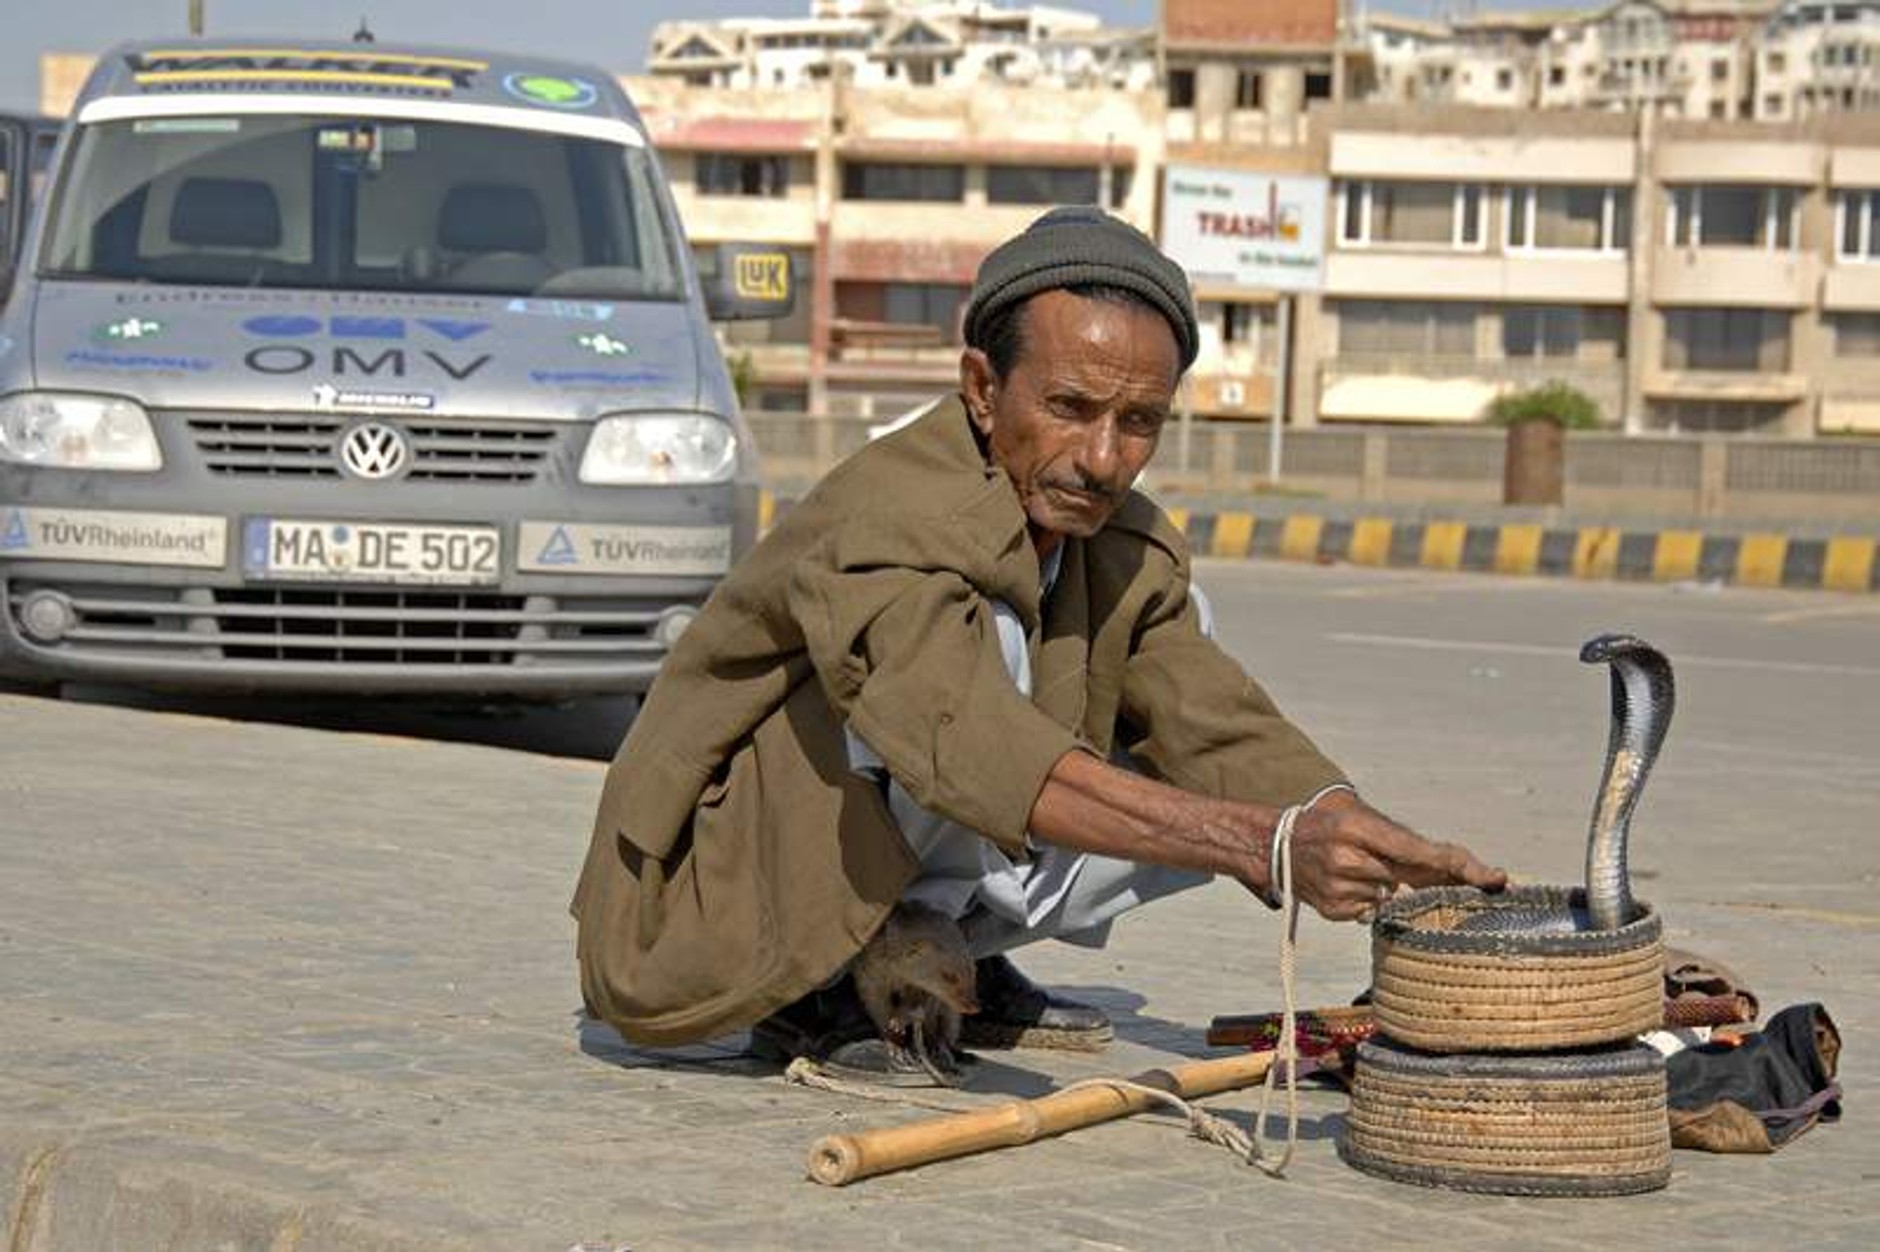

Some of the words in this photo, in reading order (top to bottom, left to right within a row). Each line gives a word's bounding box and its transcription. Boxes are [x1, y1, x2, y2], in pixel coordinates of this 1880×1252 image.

[244, 344, 492, 381] OMV
[273, 526, 328, 566] MA
[358, 529, 411, 570] DE
[420, 532, 498, 573] 502
